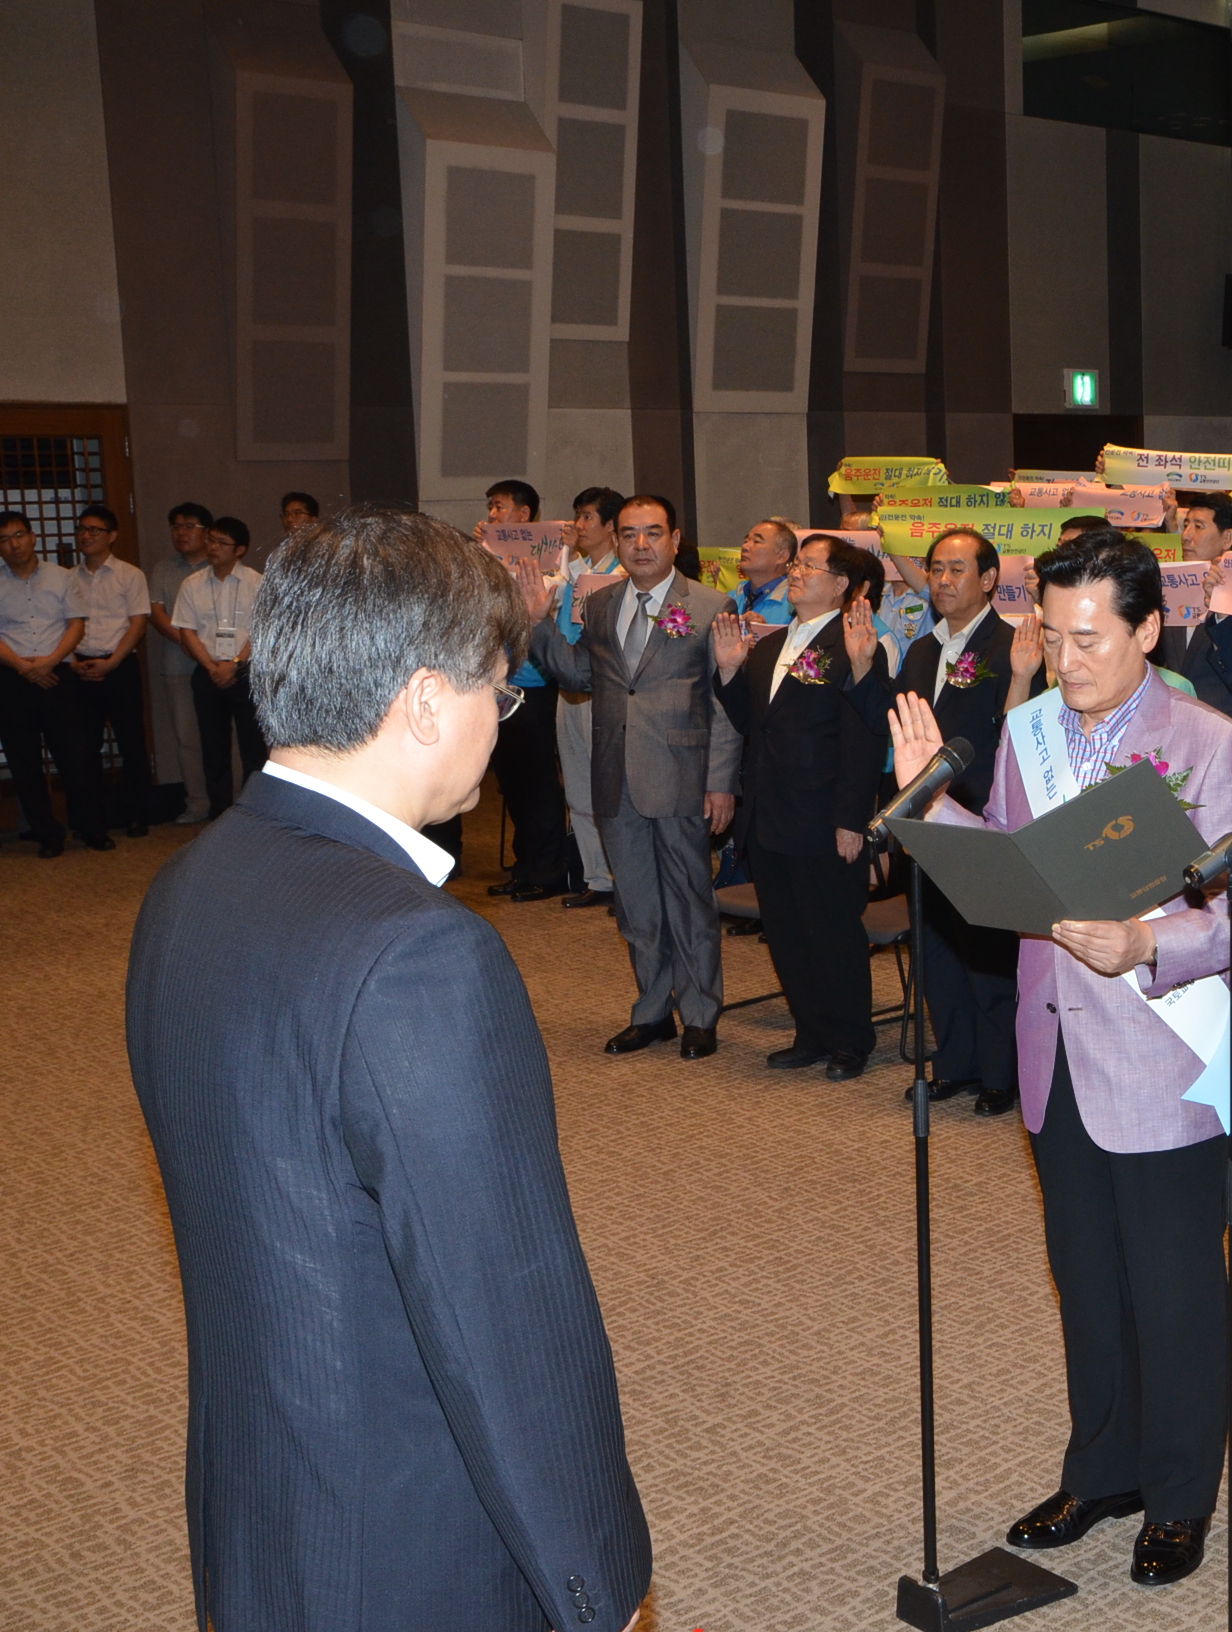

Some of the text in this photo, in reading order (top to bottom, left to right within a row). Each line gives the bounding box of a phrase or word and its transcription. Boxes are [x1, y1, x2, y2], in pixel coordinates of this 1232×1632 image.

[1136, 452, 1150, 468] 전
[1154, 454, 1184, 470] 좌석
[1188, 455, 1232, 472] 안전띠
[844, 468, 882, 481] 음주운전
[884, 467, 904, 481] 절대
[966, 492, 990, 508] 하지
[981, 523, 1014, 541] 절대
[1020, 523, 1054, 540] 하지
[1028, 707, 1058, 801] 교통사고 없는
[1083, 836, 1105, 852] TS
